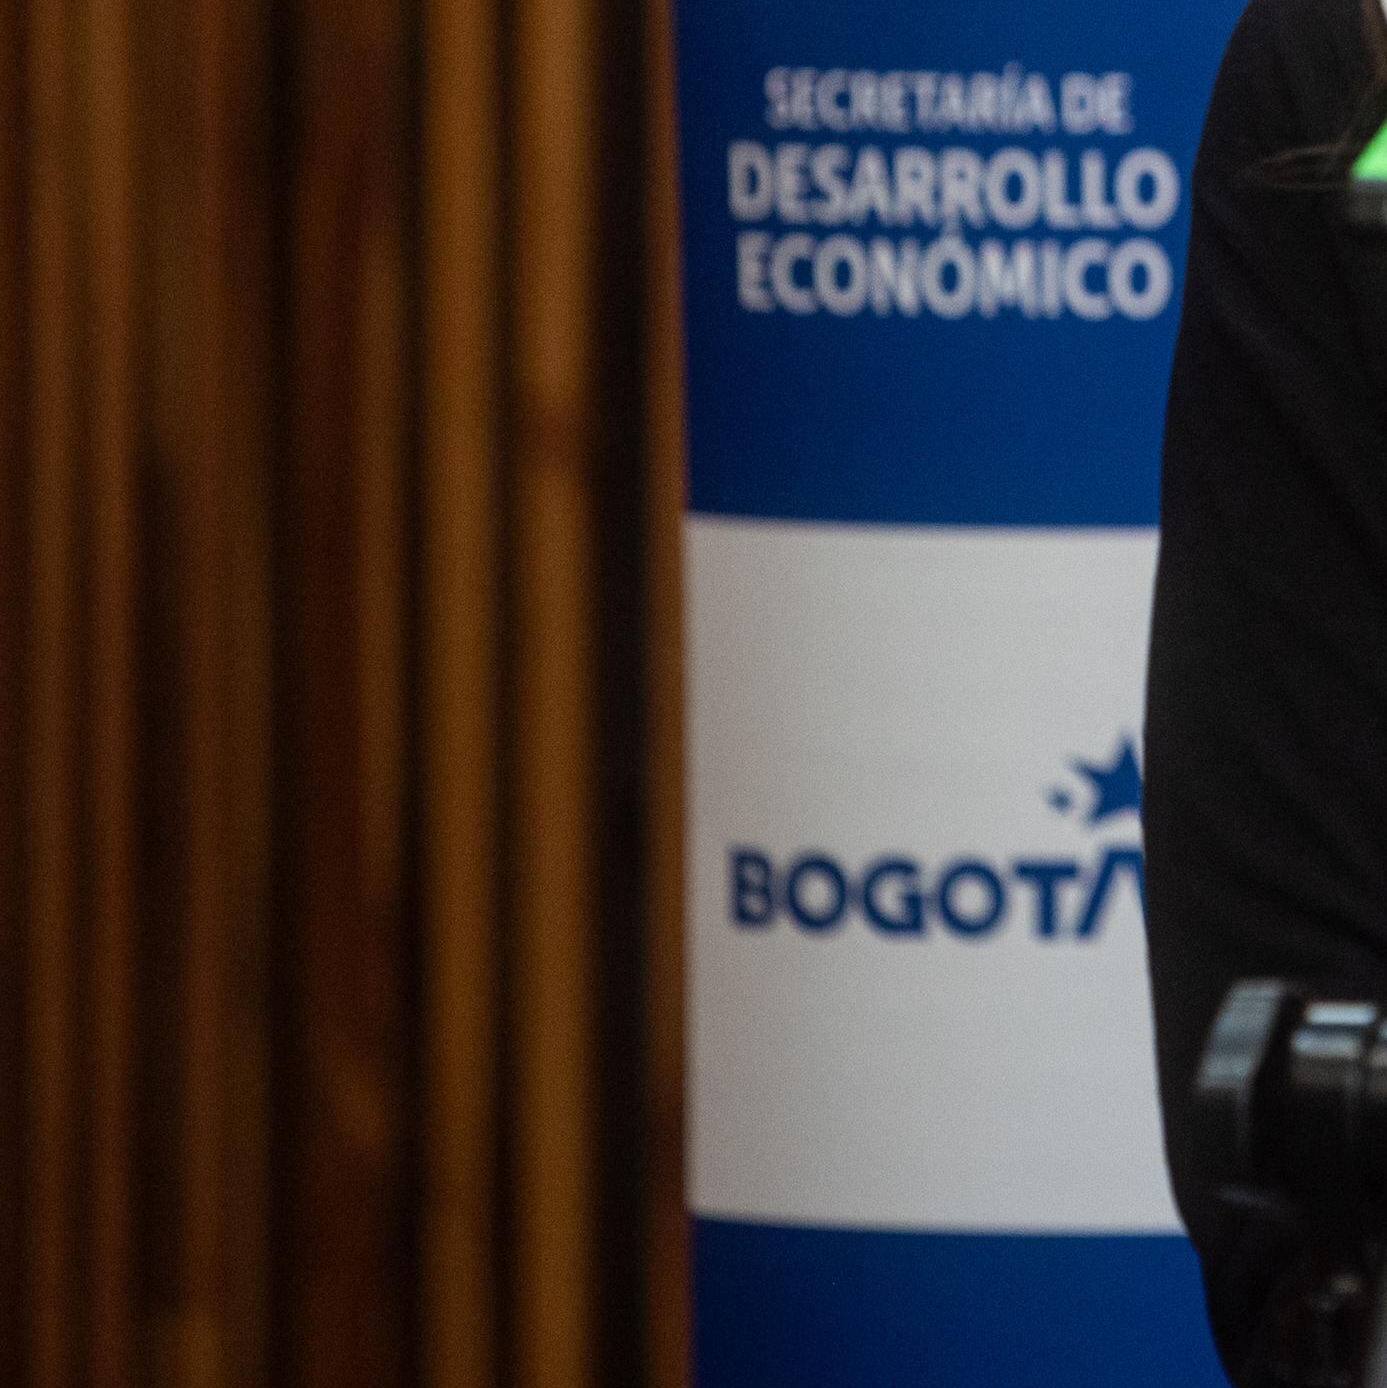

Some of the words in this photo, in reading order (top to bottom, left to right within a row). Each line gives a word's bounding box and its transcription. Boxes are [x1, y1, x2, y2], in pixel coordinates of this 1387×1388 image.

[765, 62, 1057, 133] SECRETARÍA
[1060, 72, 1133, 135] DE
[728, 141, 1180, 230] DESARROLLO
[736, 224, 1173, 320] ECONÓMICO
